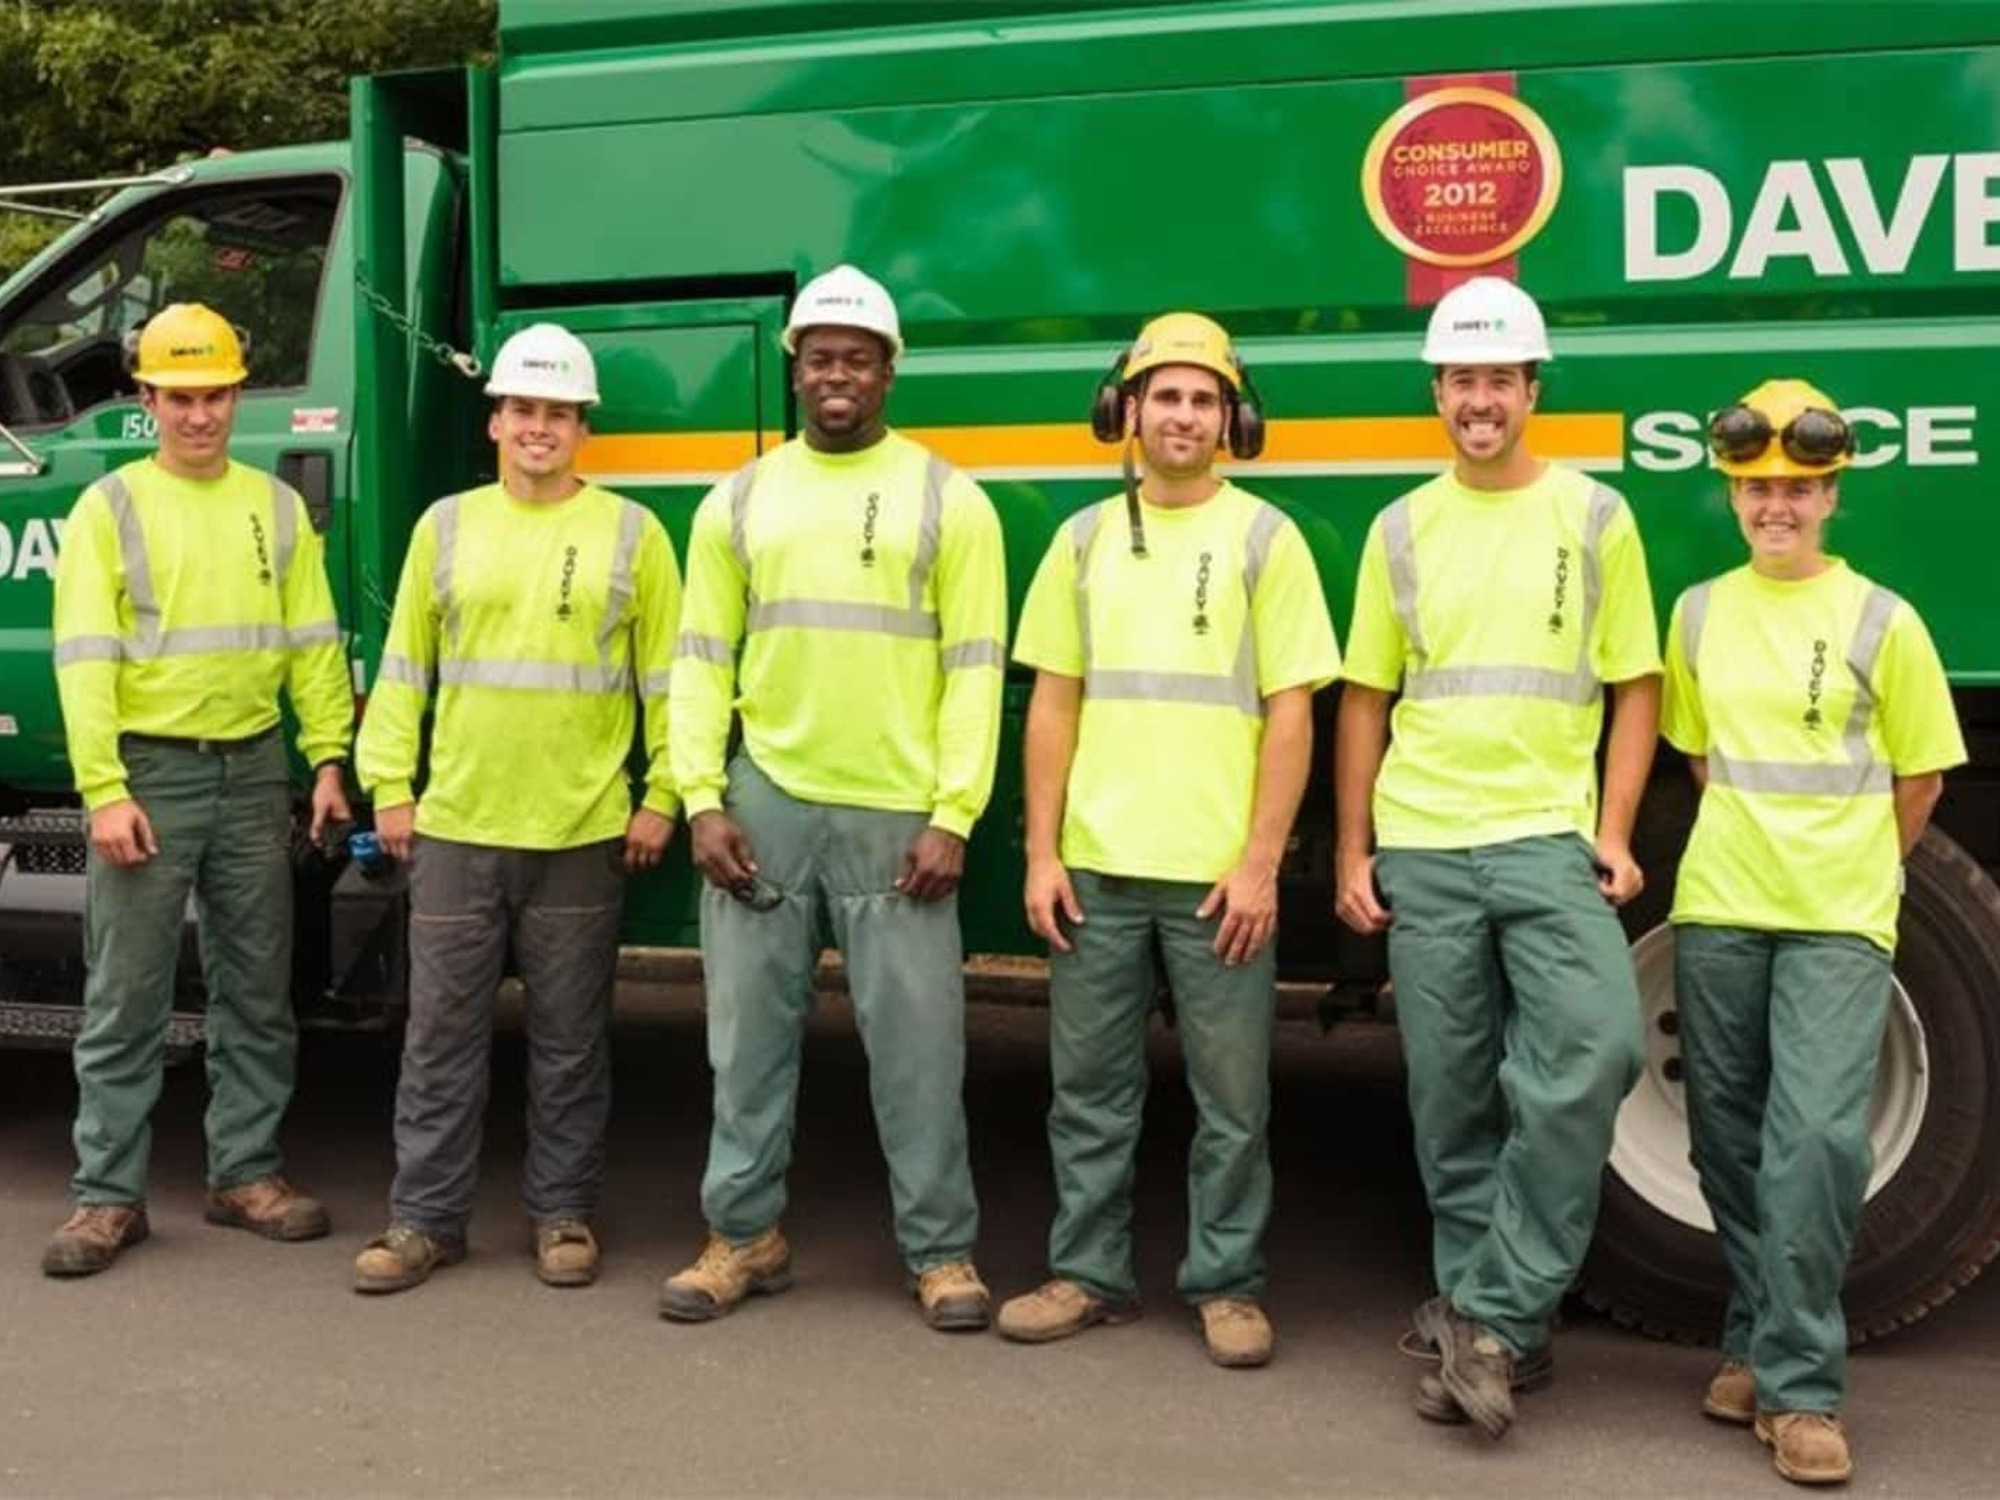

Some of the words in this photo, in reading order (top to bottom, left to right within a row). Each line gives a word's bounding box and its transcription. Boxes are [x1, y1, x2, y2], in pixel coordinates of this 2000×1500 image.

[1393, 139, 1530, 163] CONSUMER
[1394, 161, 1459, 178] CHOICE
[1467, 159, 1531, 174] AWARD
[1424, 180, 1497, 206] 2012
